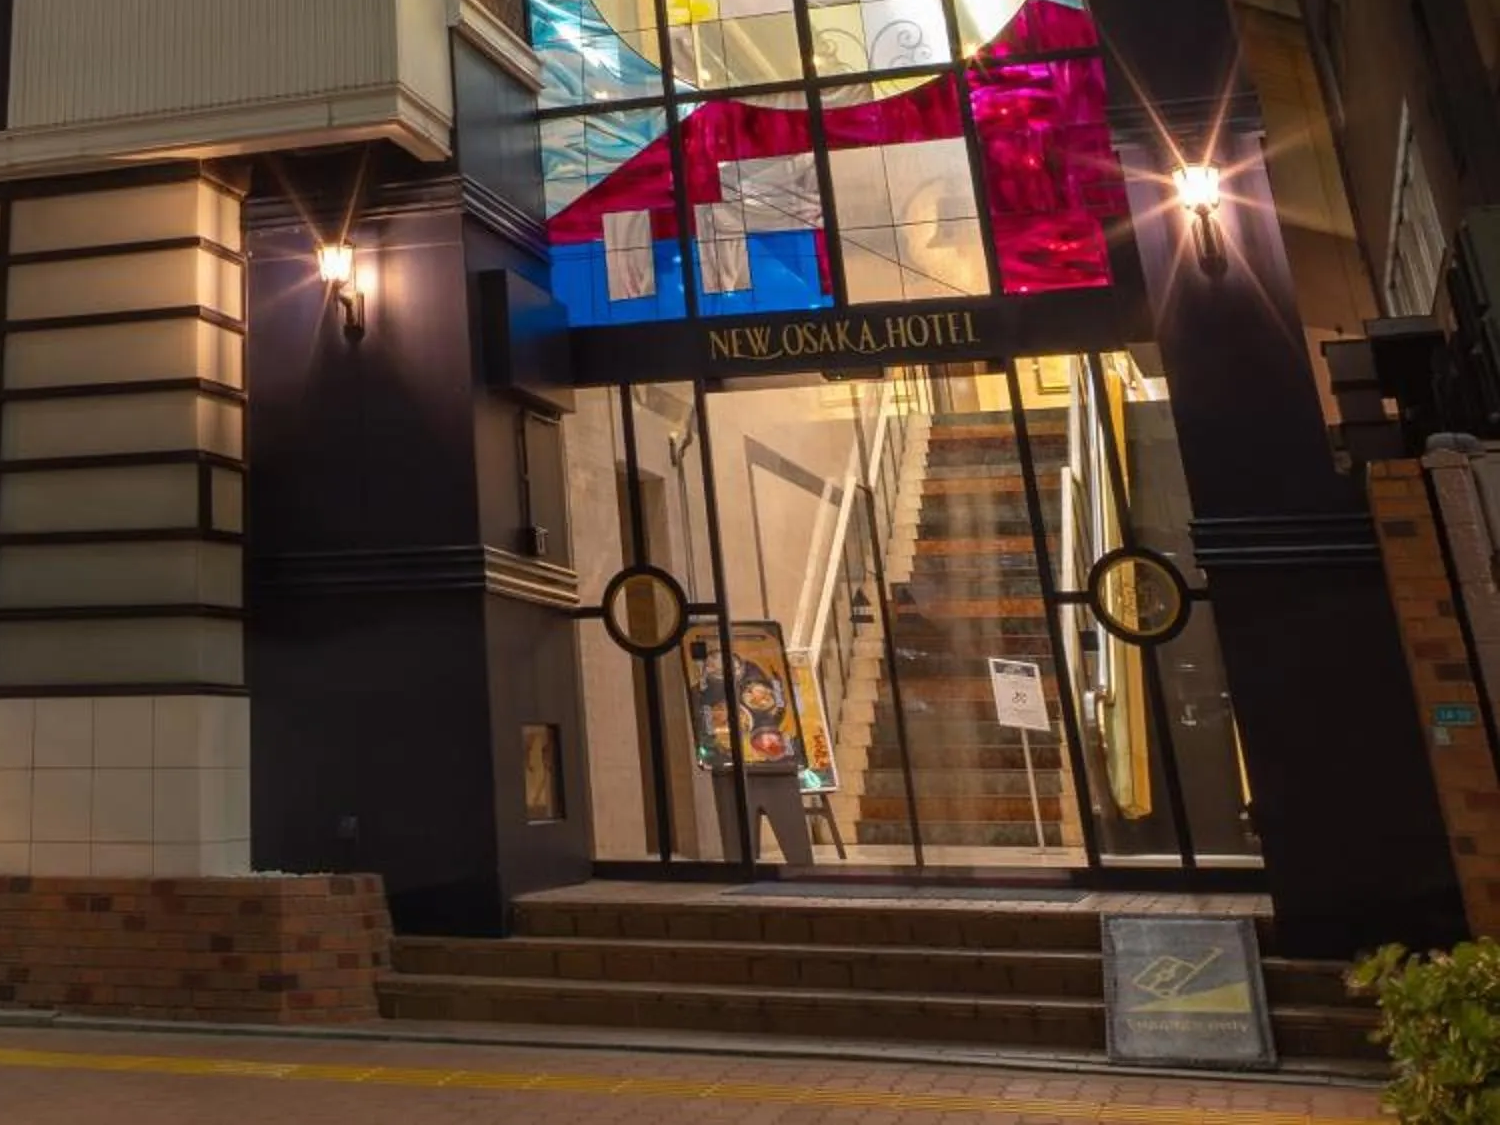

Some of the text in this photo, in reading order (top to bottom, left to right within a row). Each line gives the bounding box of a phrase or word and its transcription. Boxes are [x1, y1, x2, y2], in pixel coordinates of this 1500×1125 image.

[708, 311, 981, 360] NEW OSAKA HOTEL
